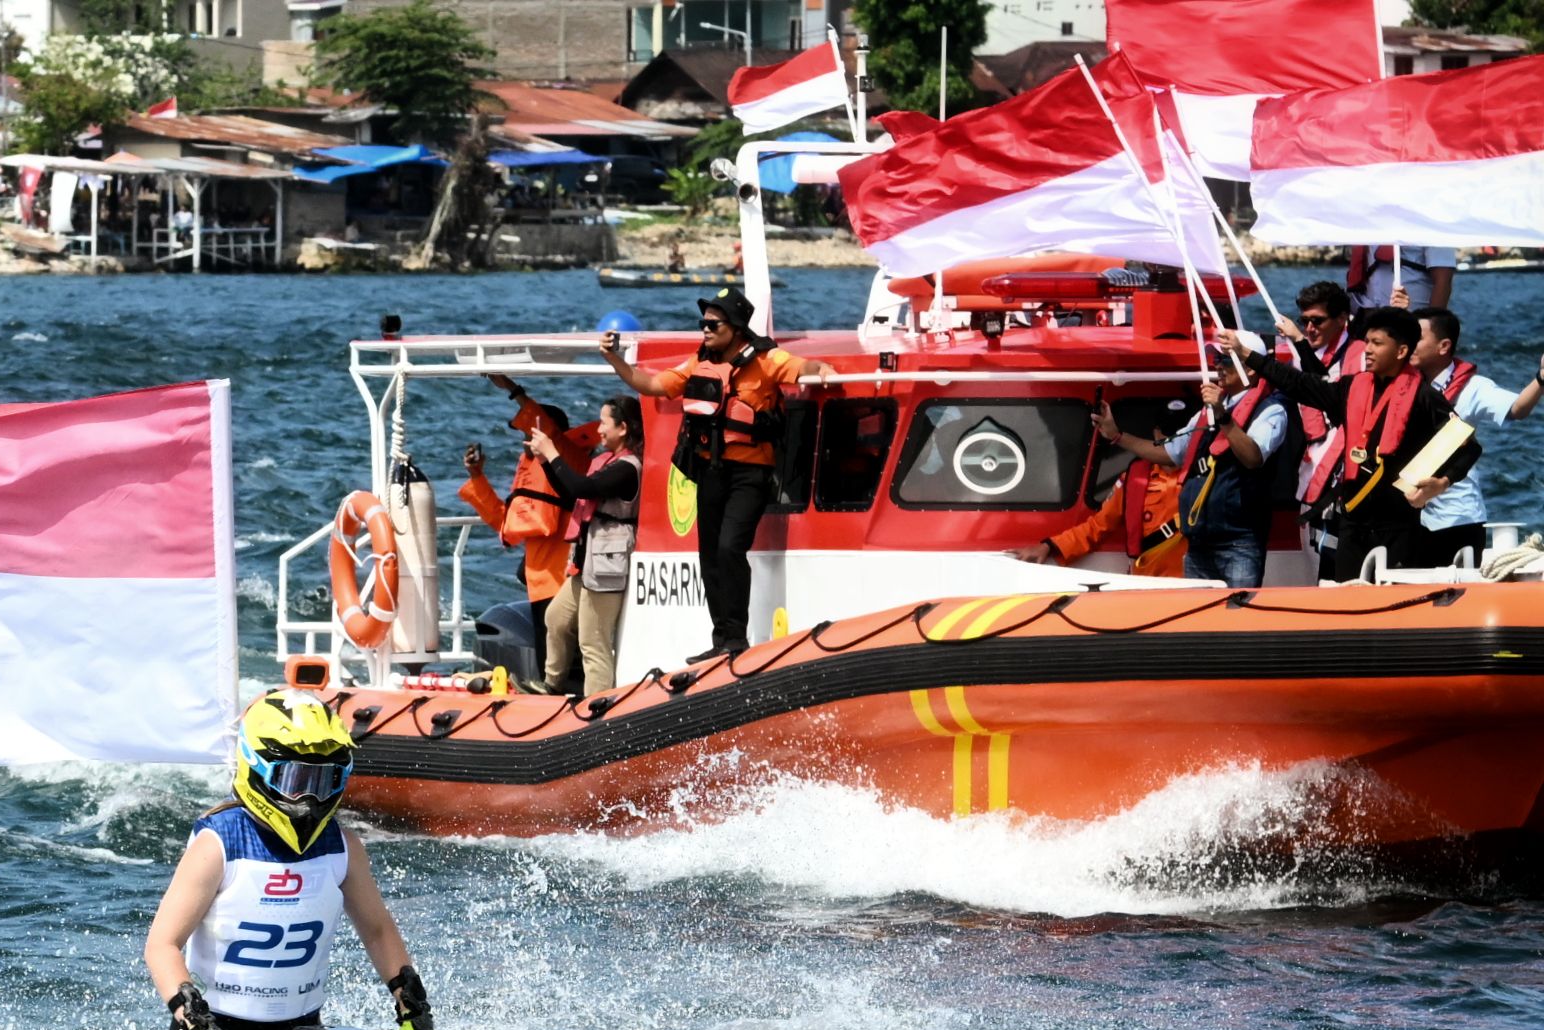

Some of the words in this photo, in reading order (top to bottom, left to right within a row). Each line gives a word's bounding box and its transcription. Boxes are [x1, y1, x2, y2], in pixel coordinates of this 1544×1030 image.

[637, 561, 706, 607] BASARN
[223, 920, 324, 969] 23
[215, 981, 241, 992] H2O
[245, 985, 288, 995] RACING
